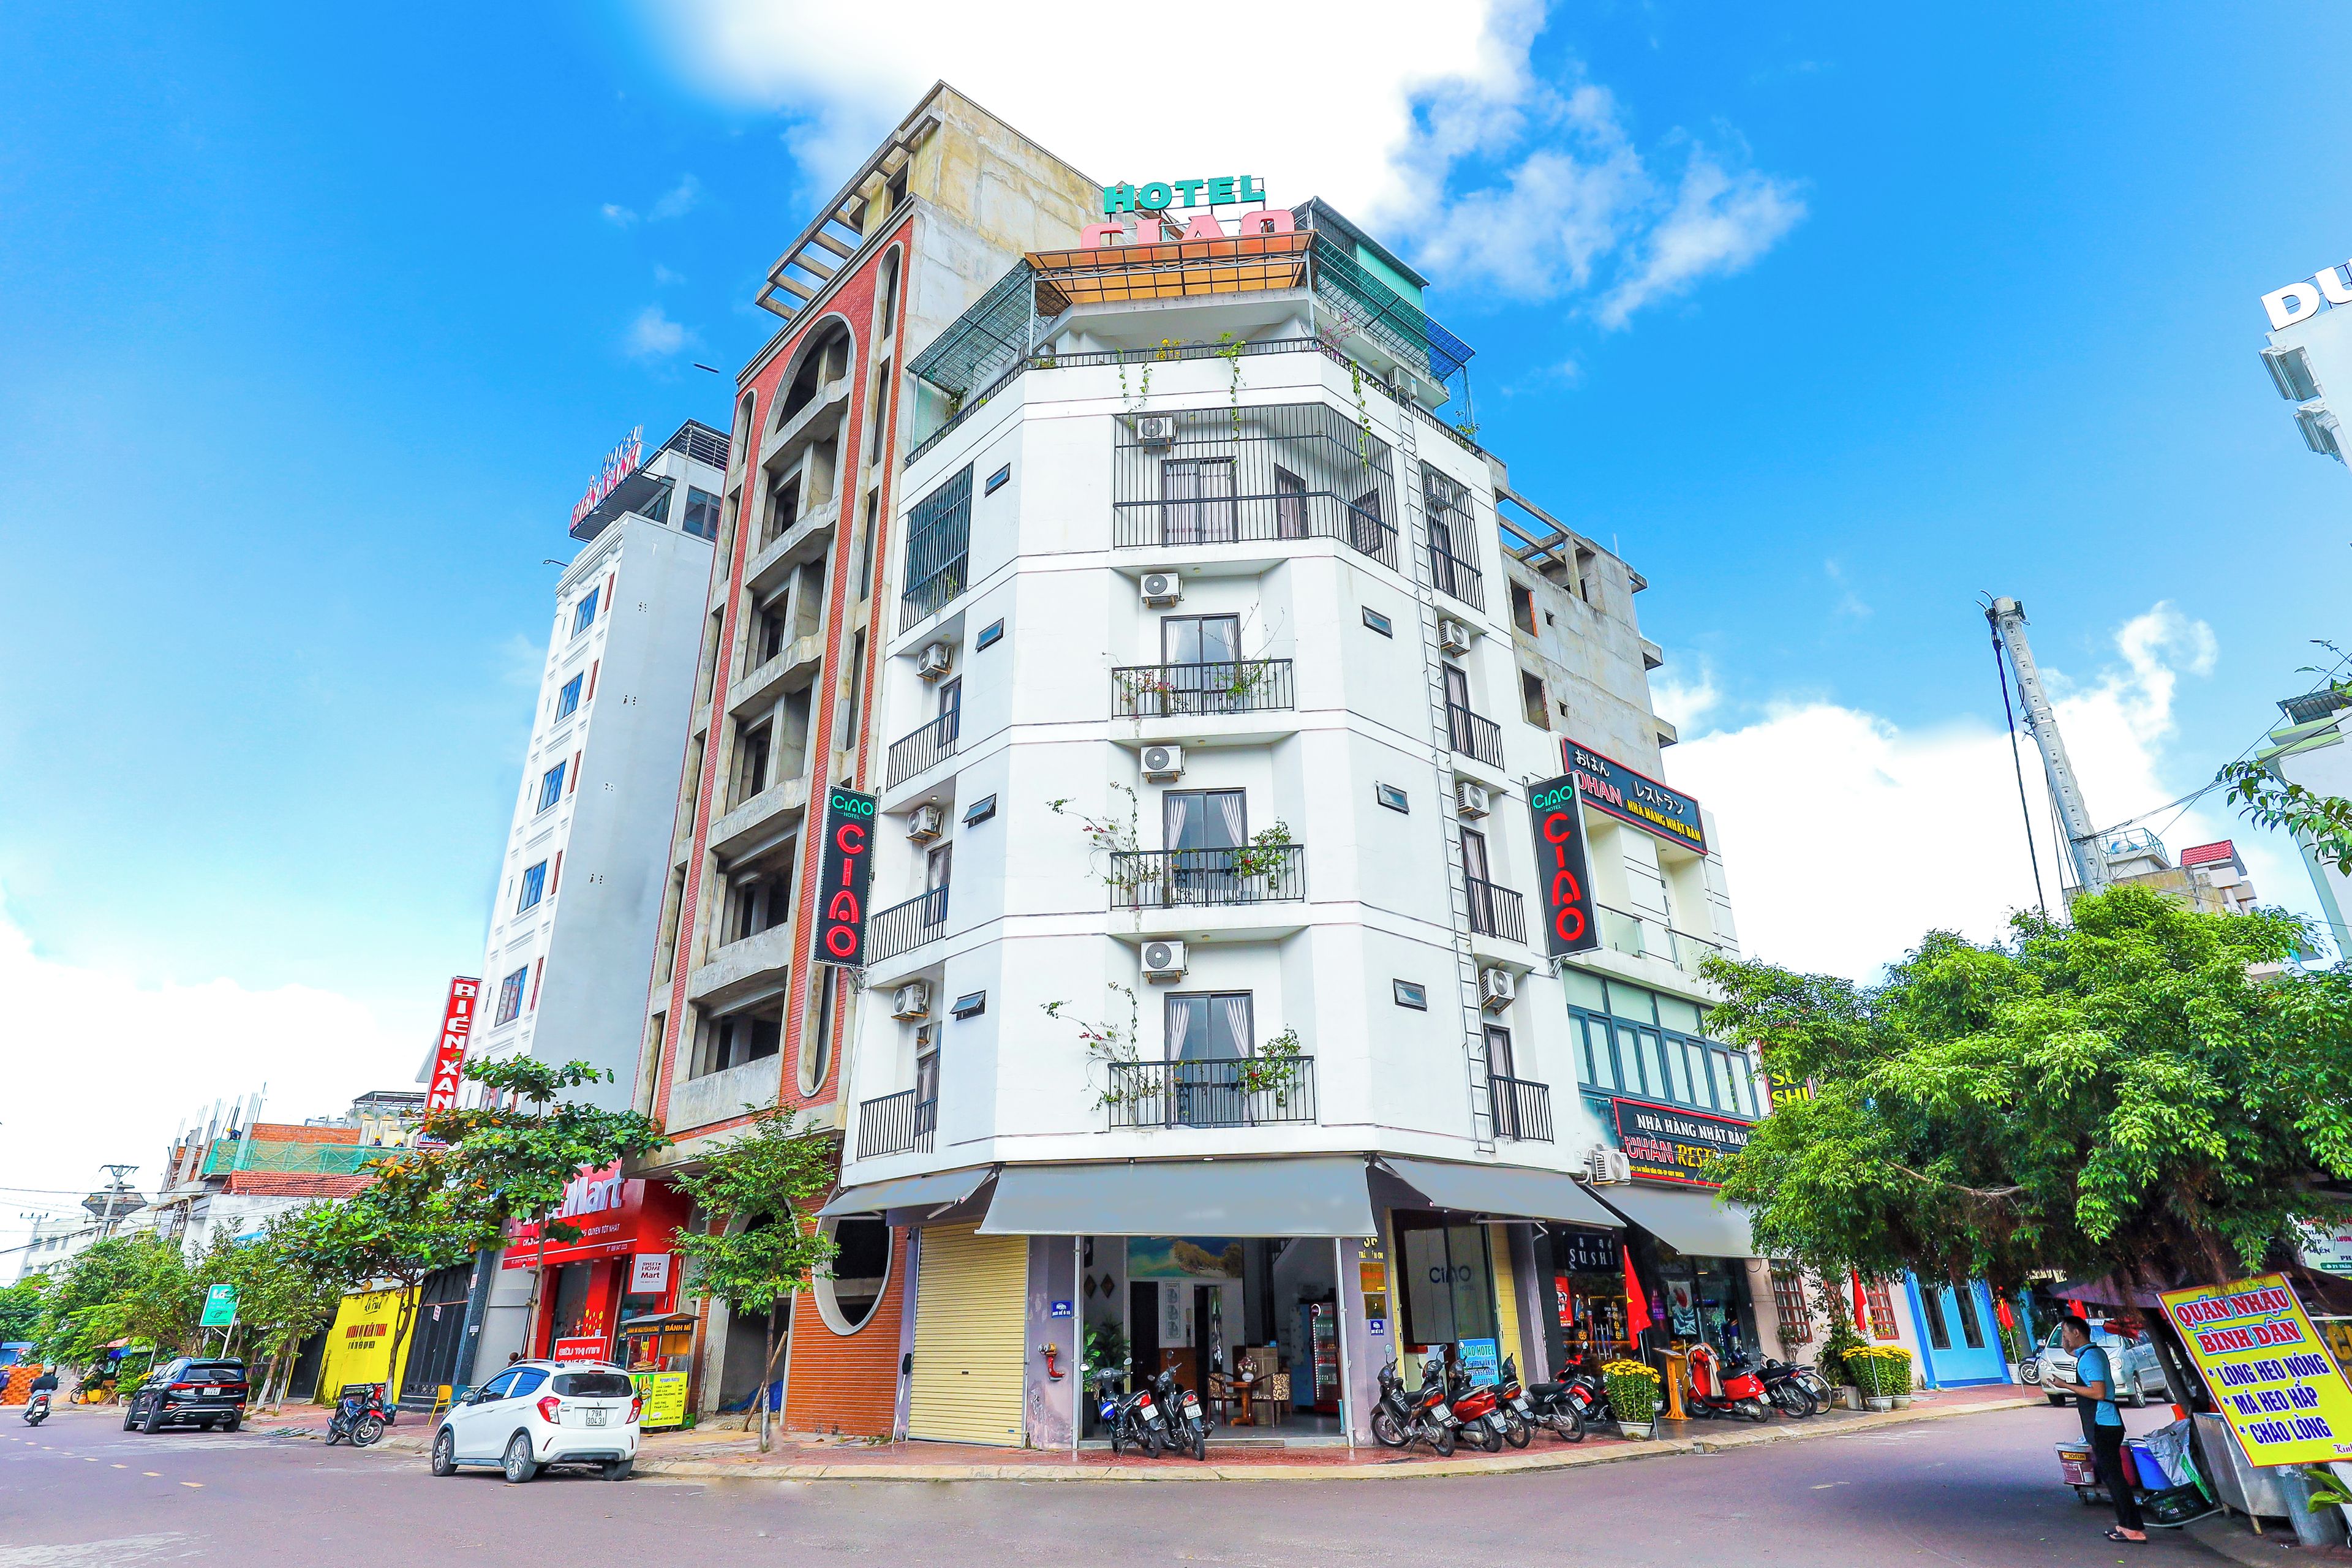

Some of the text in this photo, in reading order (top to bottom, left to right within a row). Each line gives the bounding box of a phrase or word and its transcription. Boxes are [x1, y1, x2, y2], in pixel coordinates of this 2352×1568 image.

[1104, 175, 1265, 214] HOTEL
[601, 423, 643, 477] HOTEL
[1575, 749, 1610, 777] おはん
[832, 795, 873, 816] CIAO
[1533, 785, 1573, 809] CIAO
[1575, 770, 1623, 807] OHAN
[1633, 781, 1684, 815] レストラン
[843, 812, 861, 820] HOTEL
[1627, 799, 1701, 842] NHÀ HÀNG NHẬT BẢN
[826, 824, 865, 957] CIAO
[1544, 813, 1585, 940] CIAO
[430, 1060, 460, 1110] XAN
[1771, 1087, 1809, 1108] SHI
[1636, 1113, 1662, 1132] NHÀ
[1664, 1117, 1697, 1137] HÀNG
[1698, 1123, 1727, 1144] NHẬT
[1624, 1136, 1675, 1164] OHAN
[562, 1169, 622, 1218] Mart
[1570, 1249, 1614, 1265] SUSHI
[2176, 1287, 2290, 1328] QUÁN NHẬU
[559, 1346, 574, 1355] SIÊU
[575, 1347, 585, 1355] THỊ
[1477, 1345, 1494, 1355] HOTEL
[2198, 1319, 2302, 1354] BÌNH DÂN
[2216, 1361, 2258, 1386] LÒNG
[2253, 1359, 2286, 1382] HEO
[2283, 1352, 2331, 1378] NÓNG
[2233, 1381, 2318, 1415] MÁ HEO HẤP
[2249, 1414, 2333, 1444] CHÁO LÒNG
